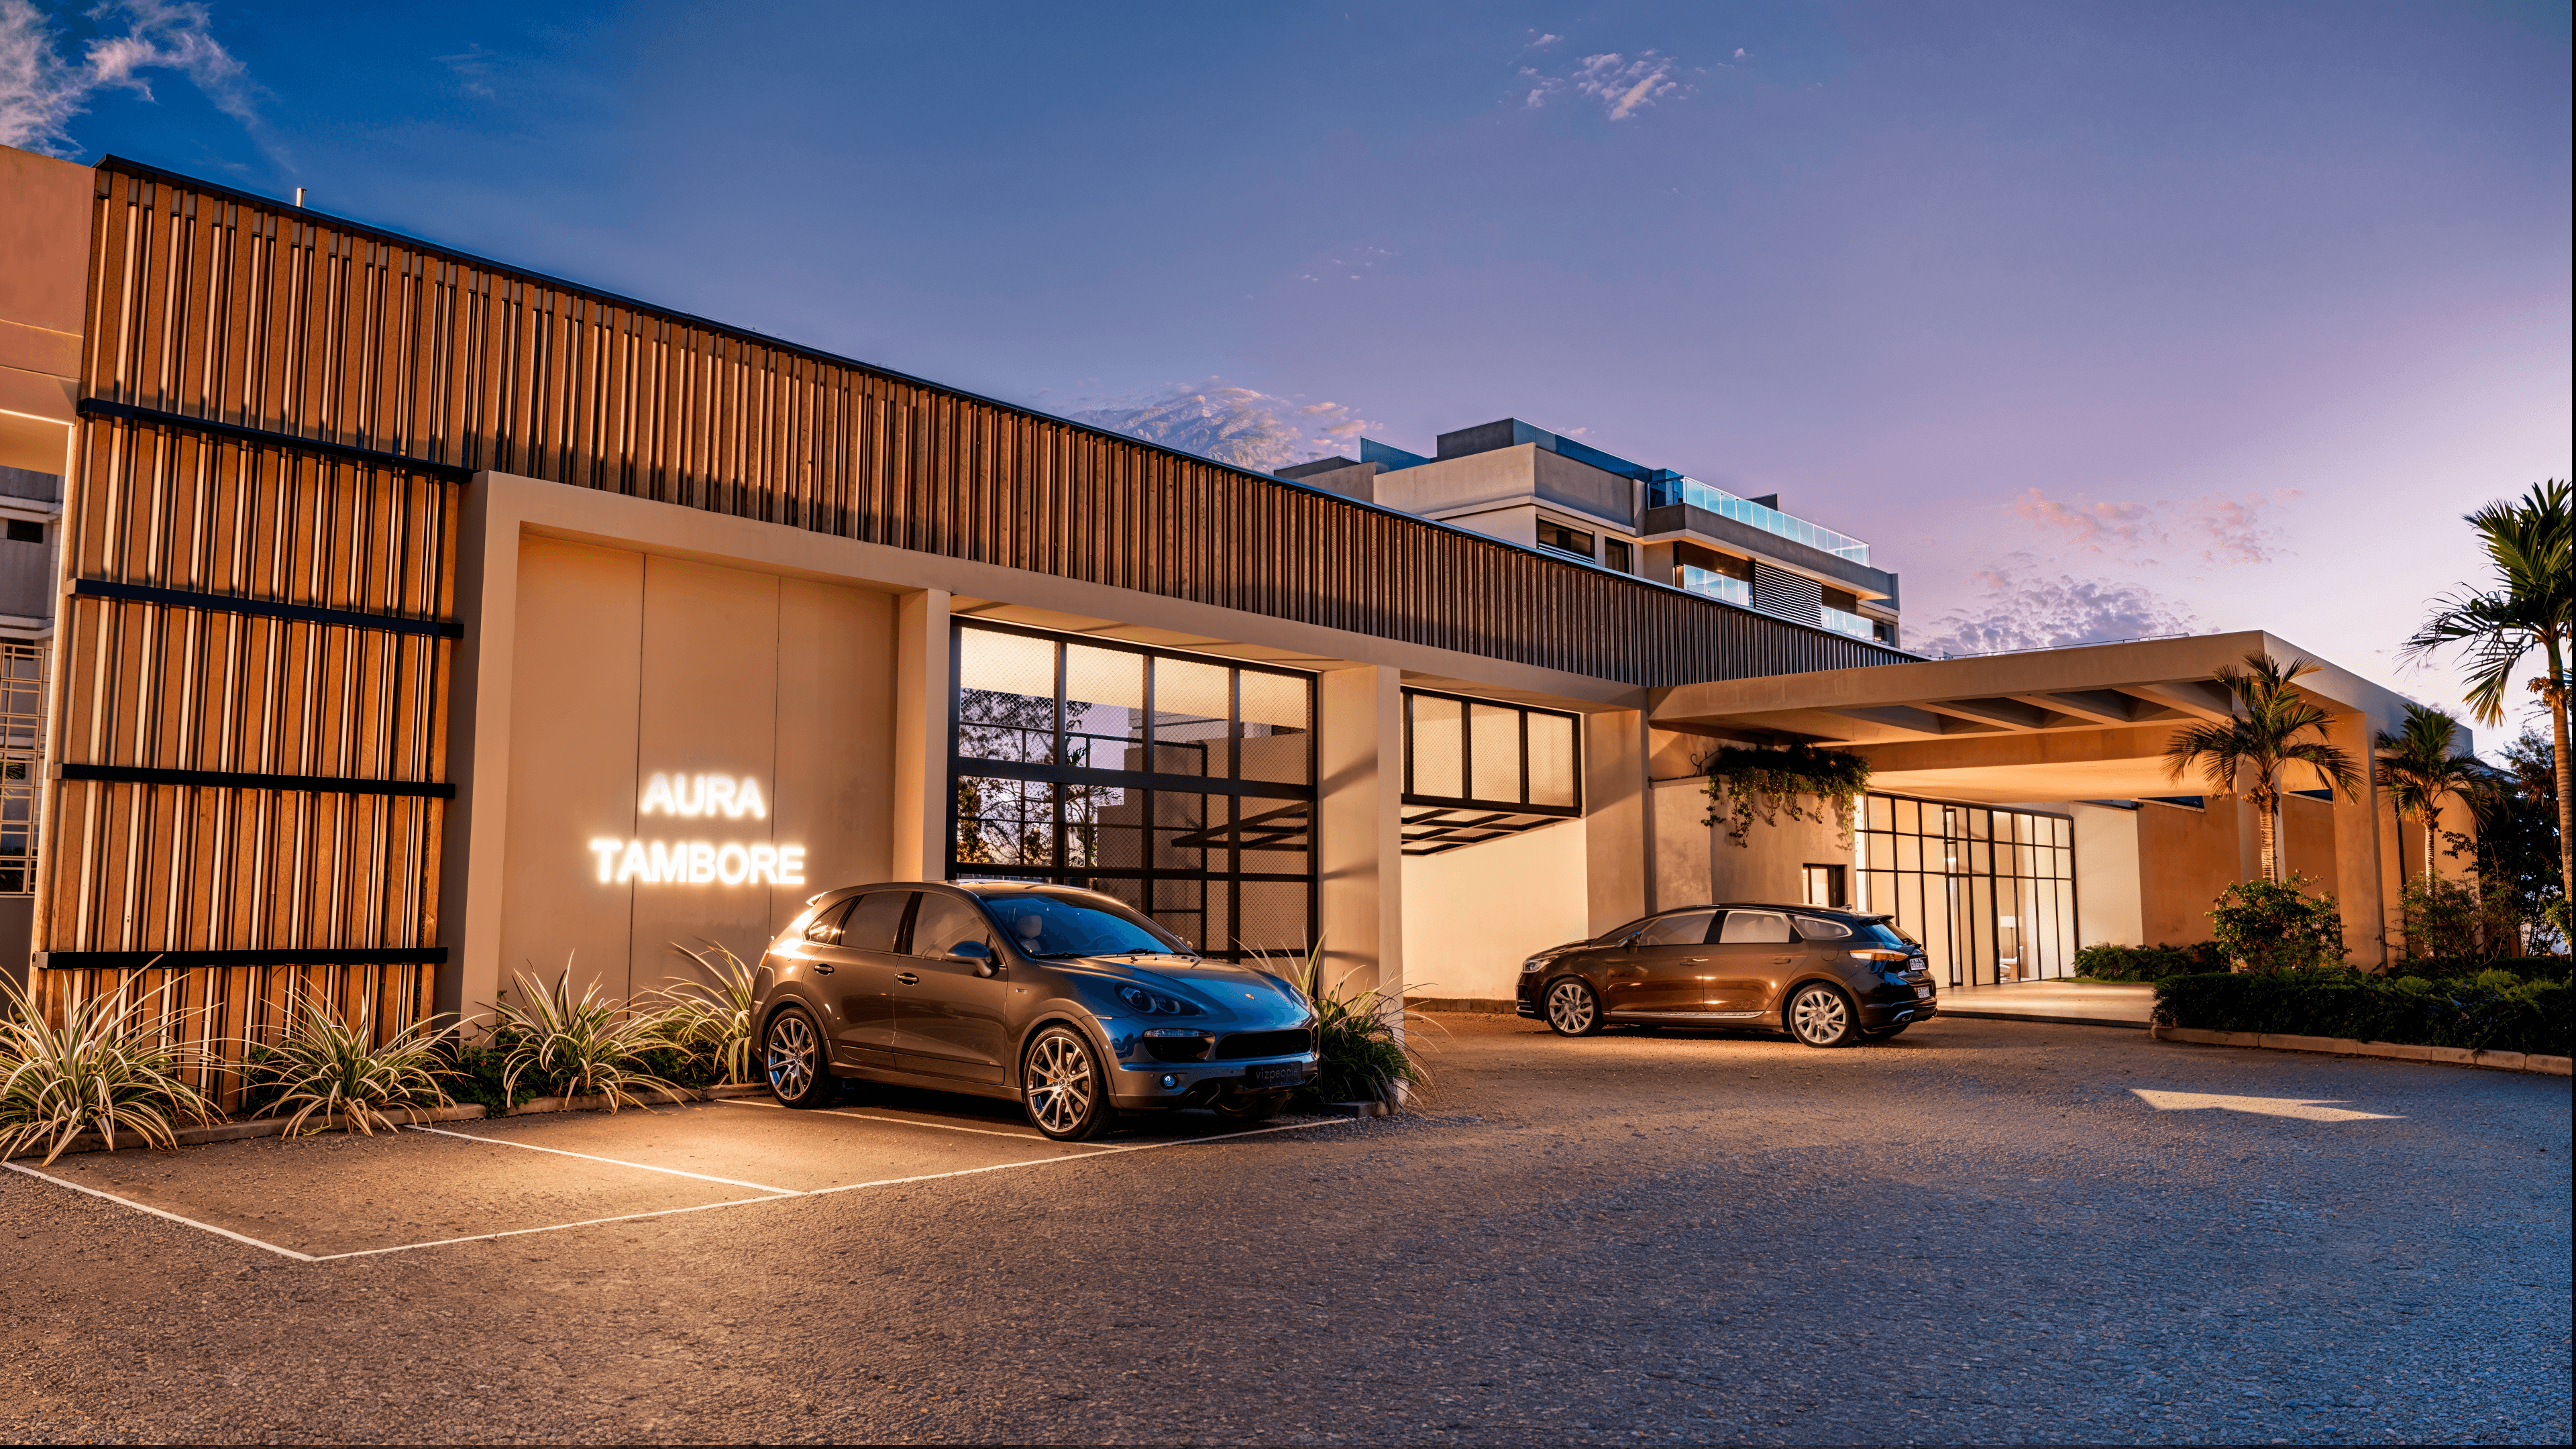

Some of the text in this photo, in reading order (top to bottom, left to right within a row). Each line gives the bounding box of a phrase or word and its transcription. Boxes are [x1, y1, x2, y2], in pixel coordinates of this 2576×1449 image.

[641, 774, 765, 818] AURA
[590, 839, 805, 885] TAMBORE
[1255, 1063, 1298, 1082] vizpeople
